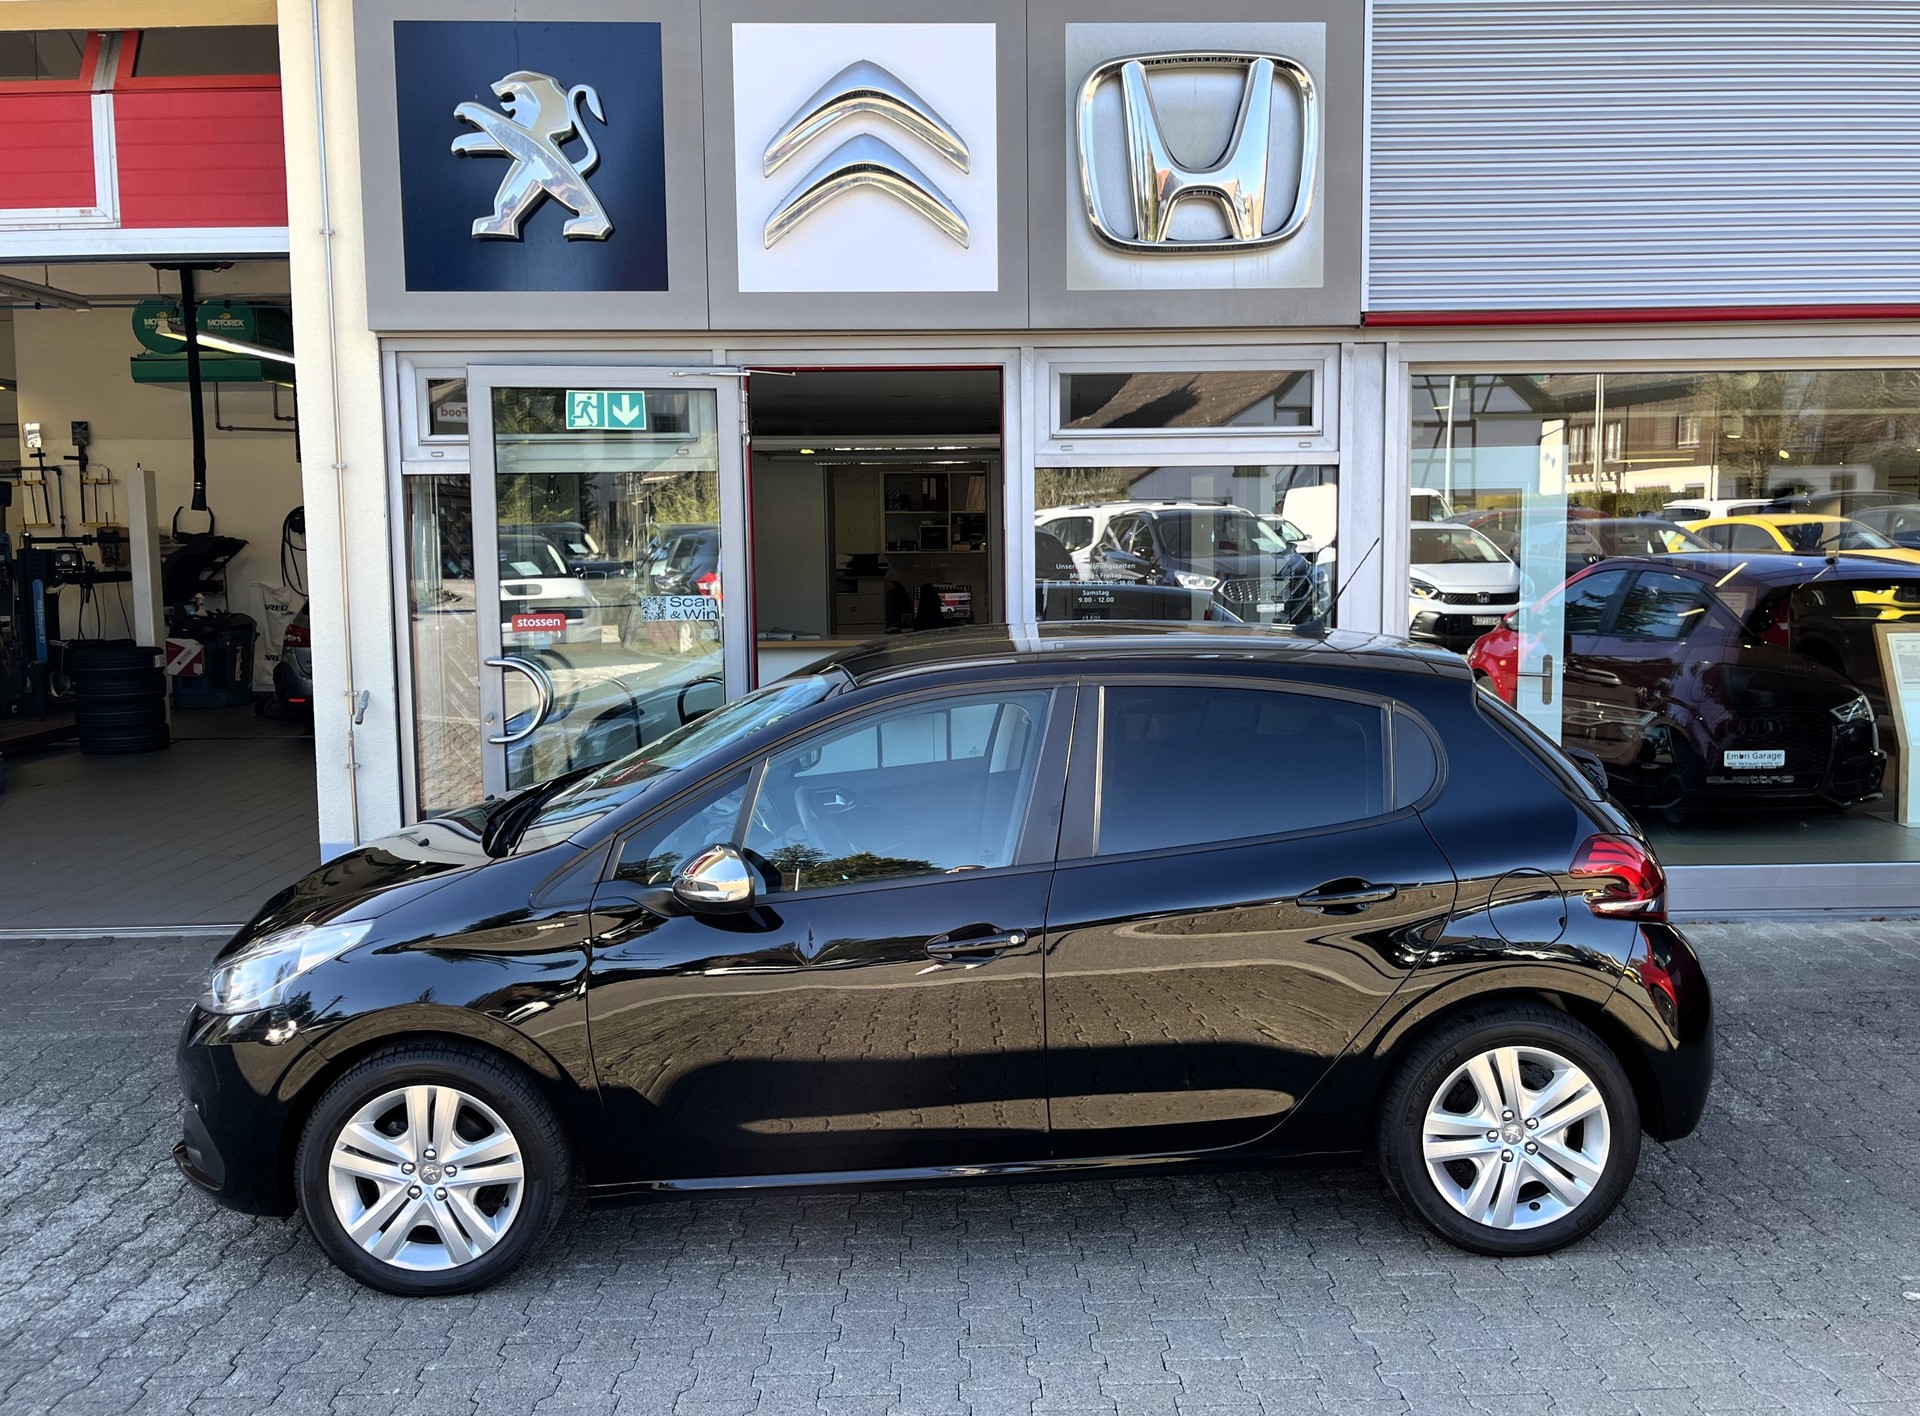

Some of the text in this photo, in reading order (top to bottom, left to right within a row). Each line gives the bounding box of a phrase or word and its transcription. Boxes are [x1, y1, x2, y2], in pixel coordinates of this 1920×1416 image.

[207, 319, 244, 327] MOTOREX
[1082, 589, 1110, 597] Samstag
[670, 596, 717, 608] Scan
[670, 607, 718, 620] & Win
[517, 618, 561, 627] stossen
[1752, 751, 1782, 761] Garage
[1706, 775, 1795, 784] quattro
